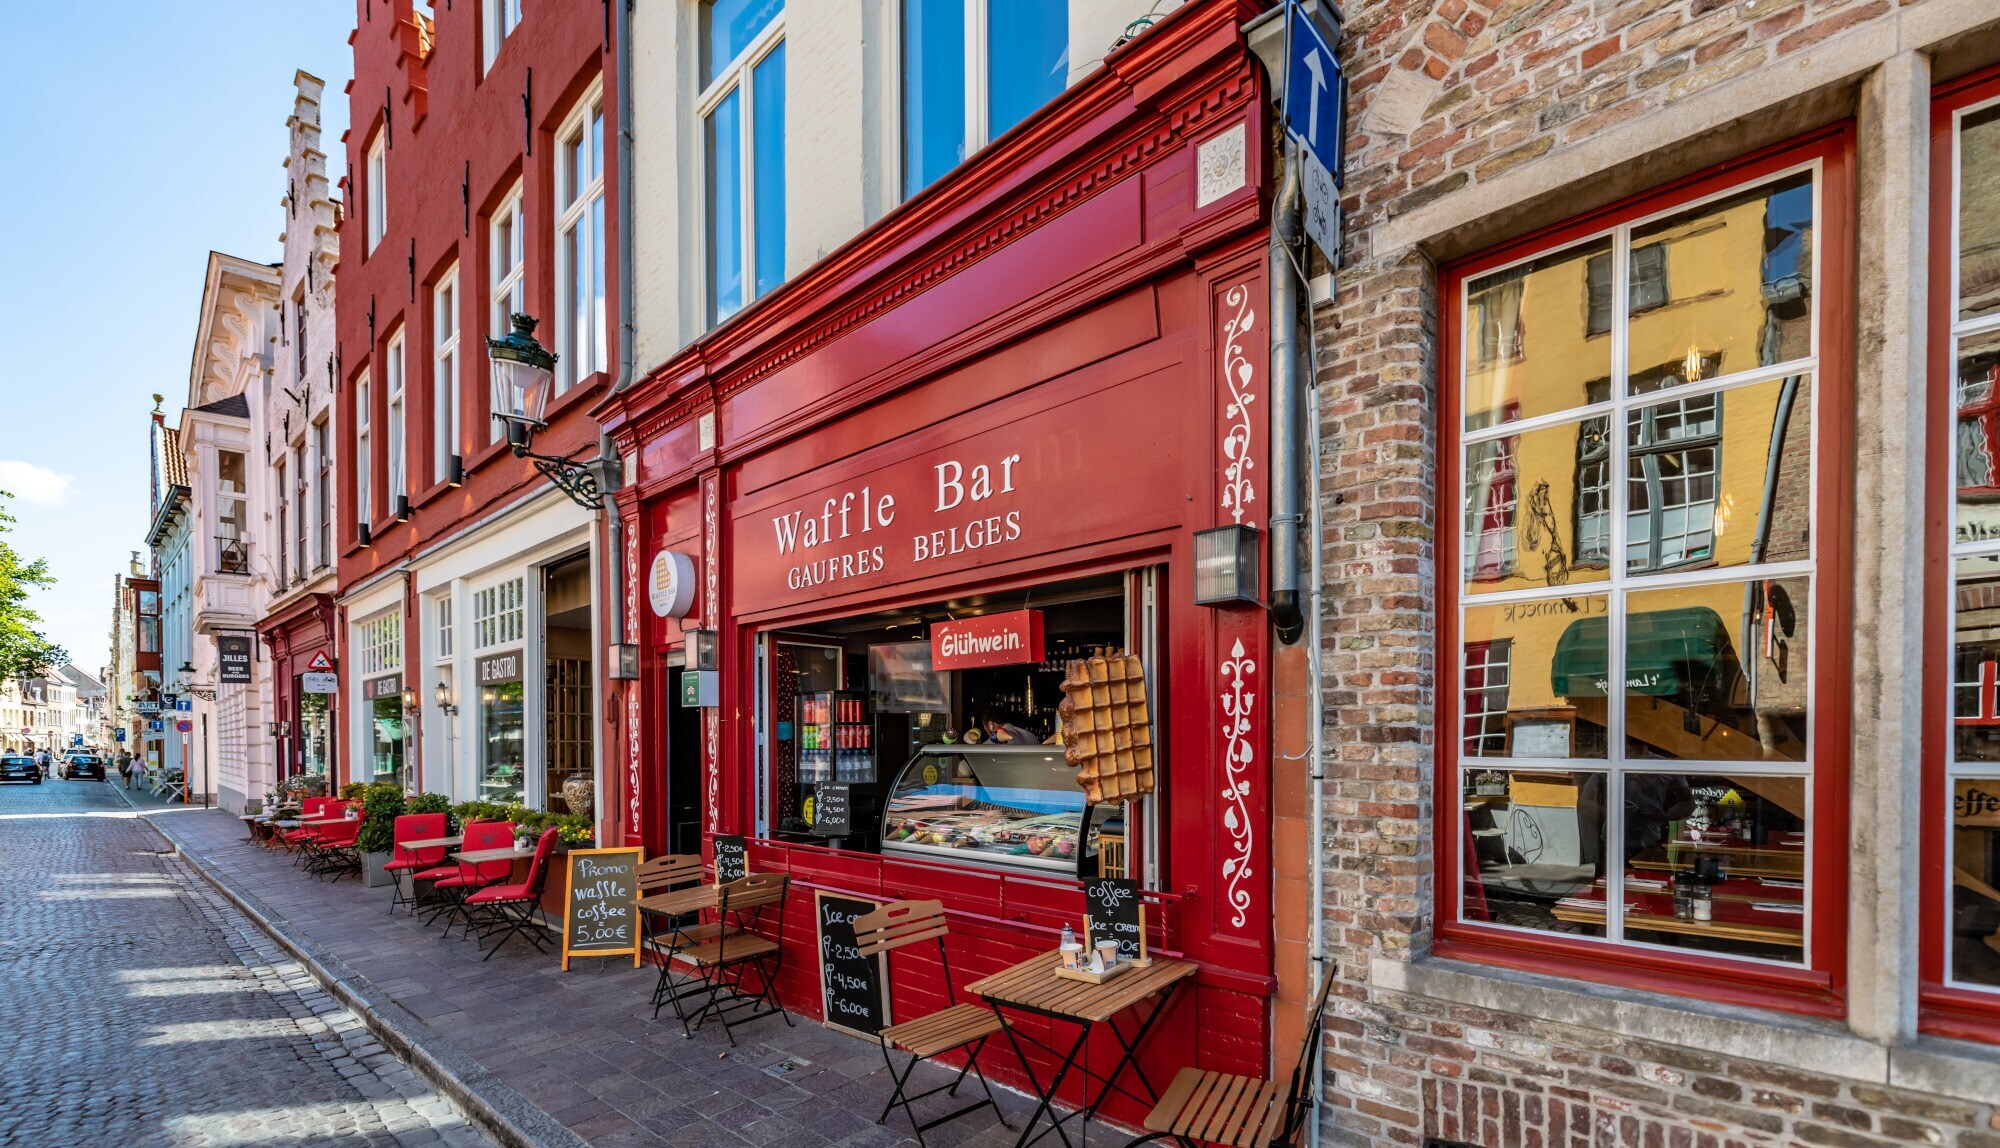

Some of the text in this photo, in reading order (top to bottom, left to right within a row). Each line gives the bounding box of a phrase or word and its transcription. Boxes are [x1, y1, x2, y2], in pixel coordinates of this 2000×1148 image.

[773, 454, 1020, 555] Waffle Bar
[788, 510, 1021, 590] GAUFRES BELGES
[941, 628, 1020, 657] Glühwein
[222, 654, 248, 663] JILLES
[482, 655, 516, 681] DE GASTRO
[377, 677, 397, 695] DE GASTRO
[574, 881, 627, 901] waffle
[1088, 880, 1133, 908] coffee
[577, 905, 627, 922] coffee
[823, 904, 845, 926] Ice
[577, 925, 628, 942] 5,00€
